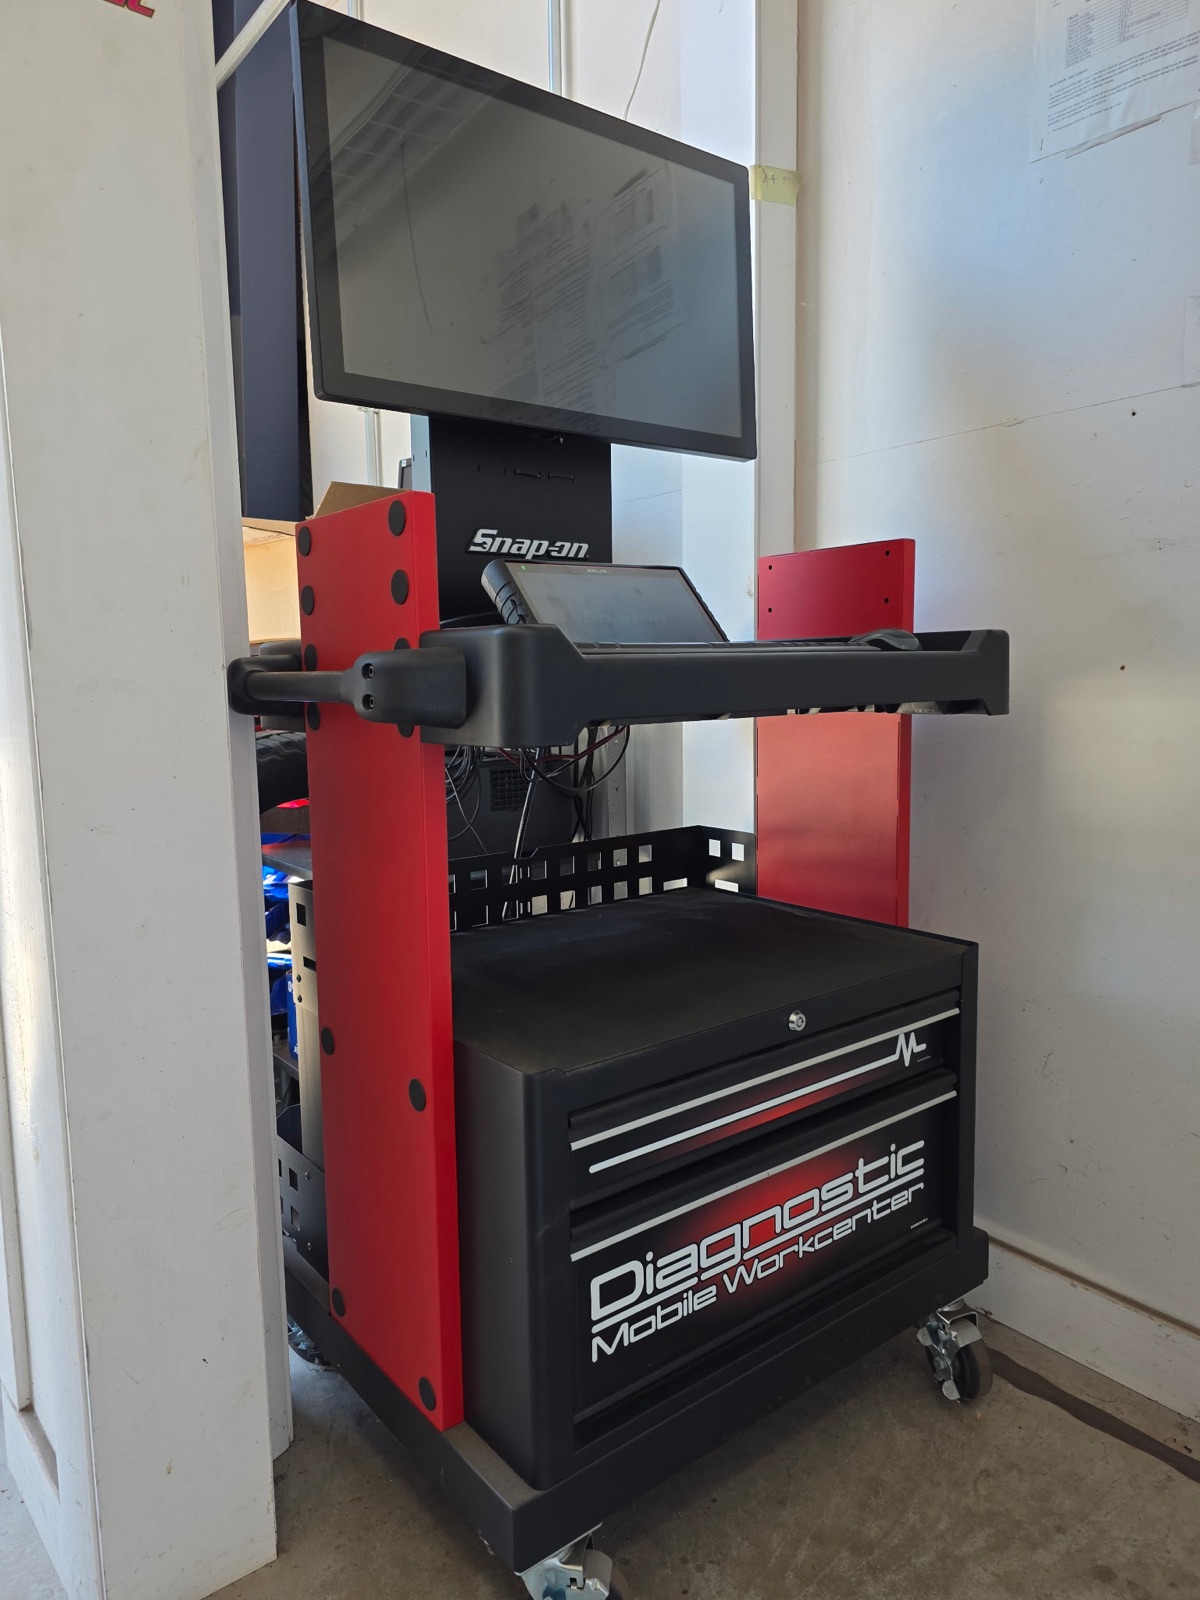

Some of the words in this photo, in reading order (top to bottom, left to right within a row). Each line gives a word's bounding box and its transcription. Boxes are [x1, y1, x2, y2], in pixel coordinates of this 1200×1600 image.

[469, 528, 589, 560] Snap-on
[590, 1139, 925, 1322] Diagnostic
[591, 1285, 717, 1363] Mobile
[723, 1182, 925, 1294] Workcenter
